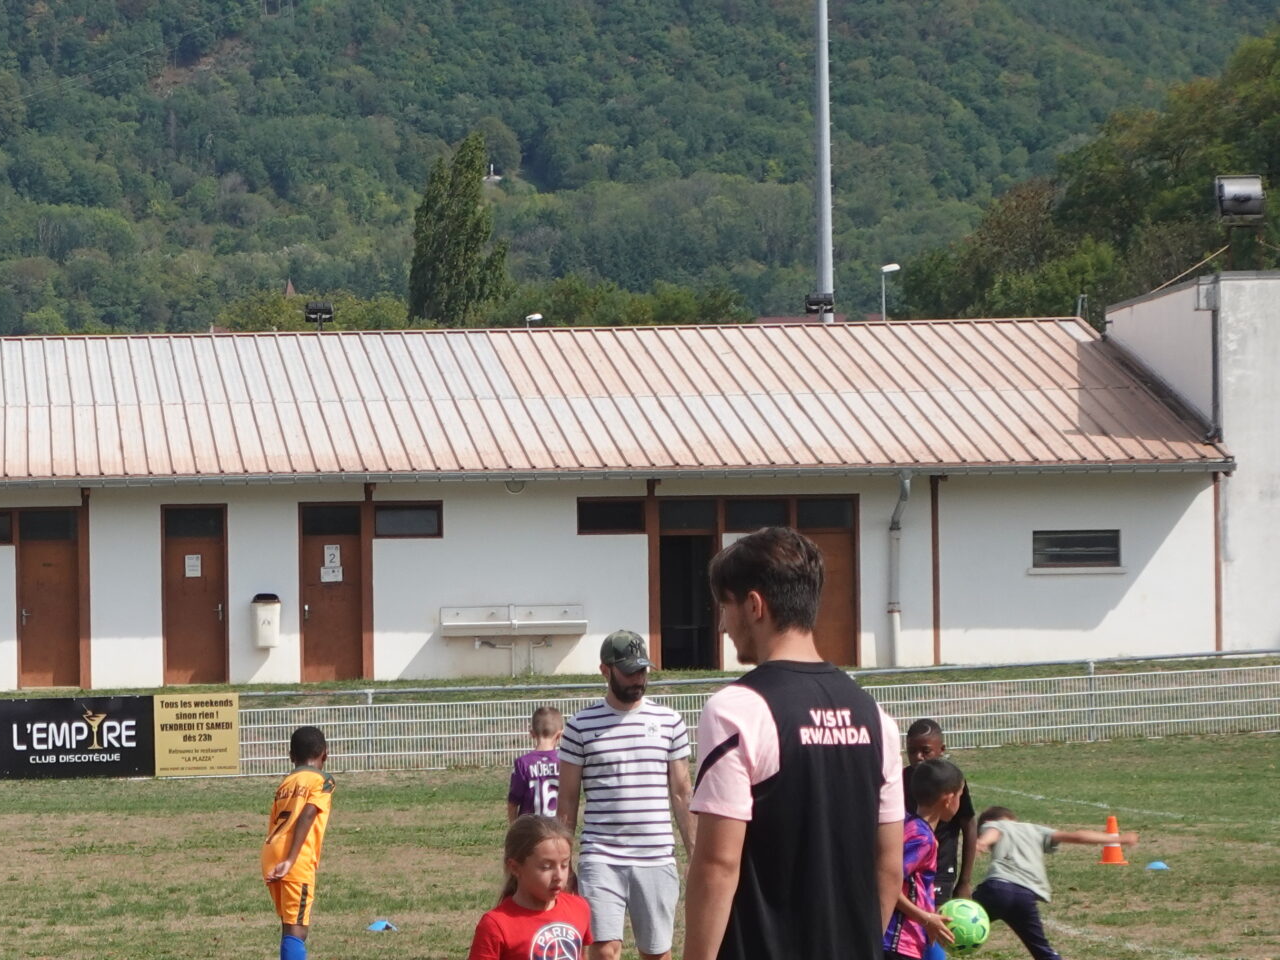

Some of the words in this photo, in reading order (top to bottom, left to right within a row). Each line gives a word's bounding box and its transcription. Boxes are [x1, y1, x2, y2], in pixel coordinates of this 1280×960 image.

[329, 553, 336, 563] 2
[160, 700, 178, 708] Tous
[180, 700, 192, 708] les
[194, 699, 233, 707] weekends
[176, 712, 197, 720] sinon
[199, 711, 214, 719] rien
[809, 709, 851, 727] VISIT
[160, 723, 195, 731] VENDREDI
[206, 722, 233, 730] SAMEDI
[198, 734, 212, 742] 23h
[800, 727, 871, 745] RWANDA
[29, 755, 56, 763] CLUB
[529, 779, 559, 817] 16
[536, 926, 577, 947] PARIS
